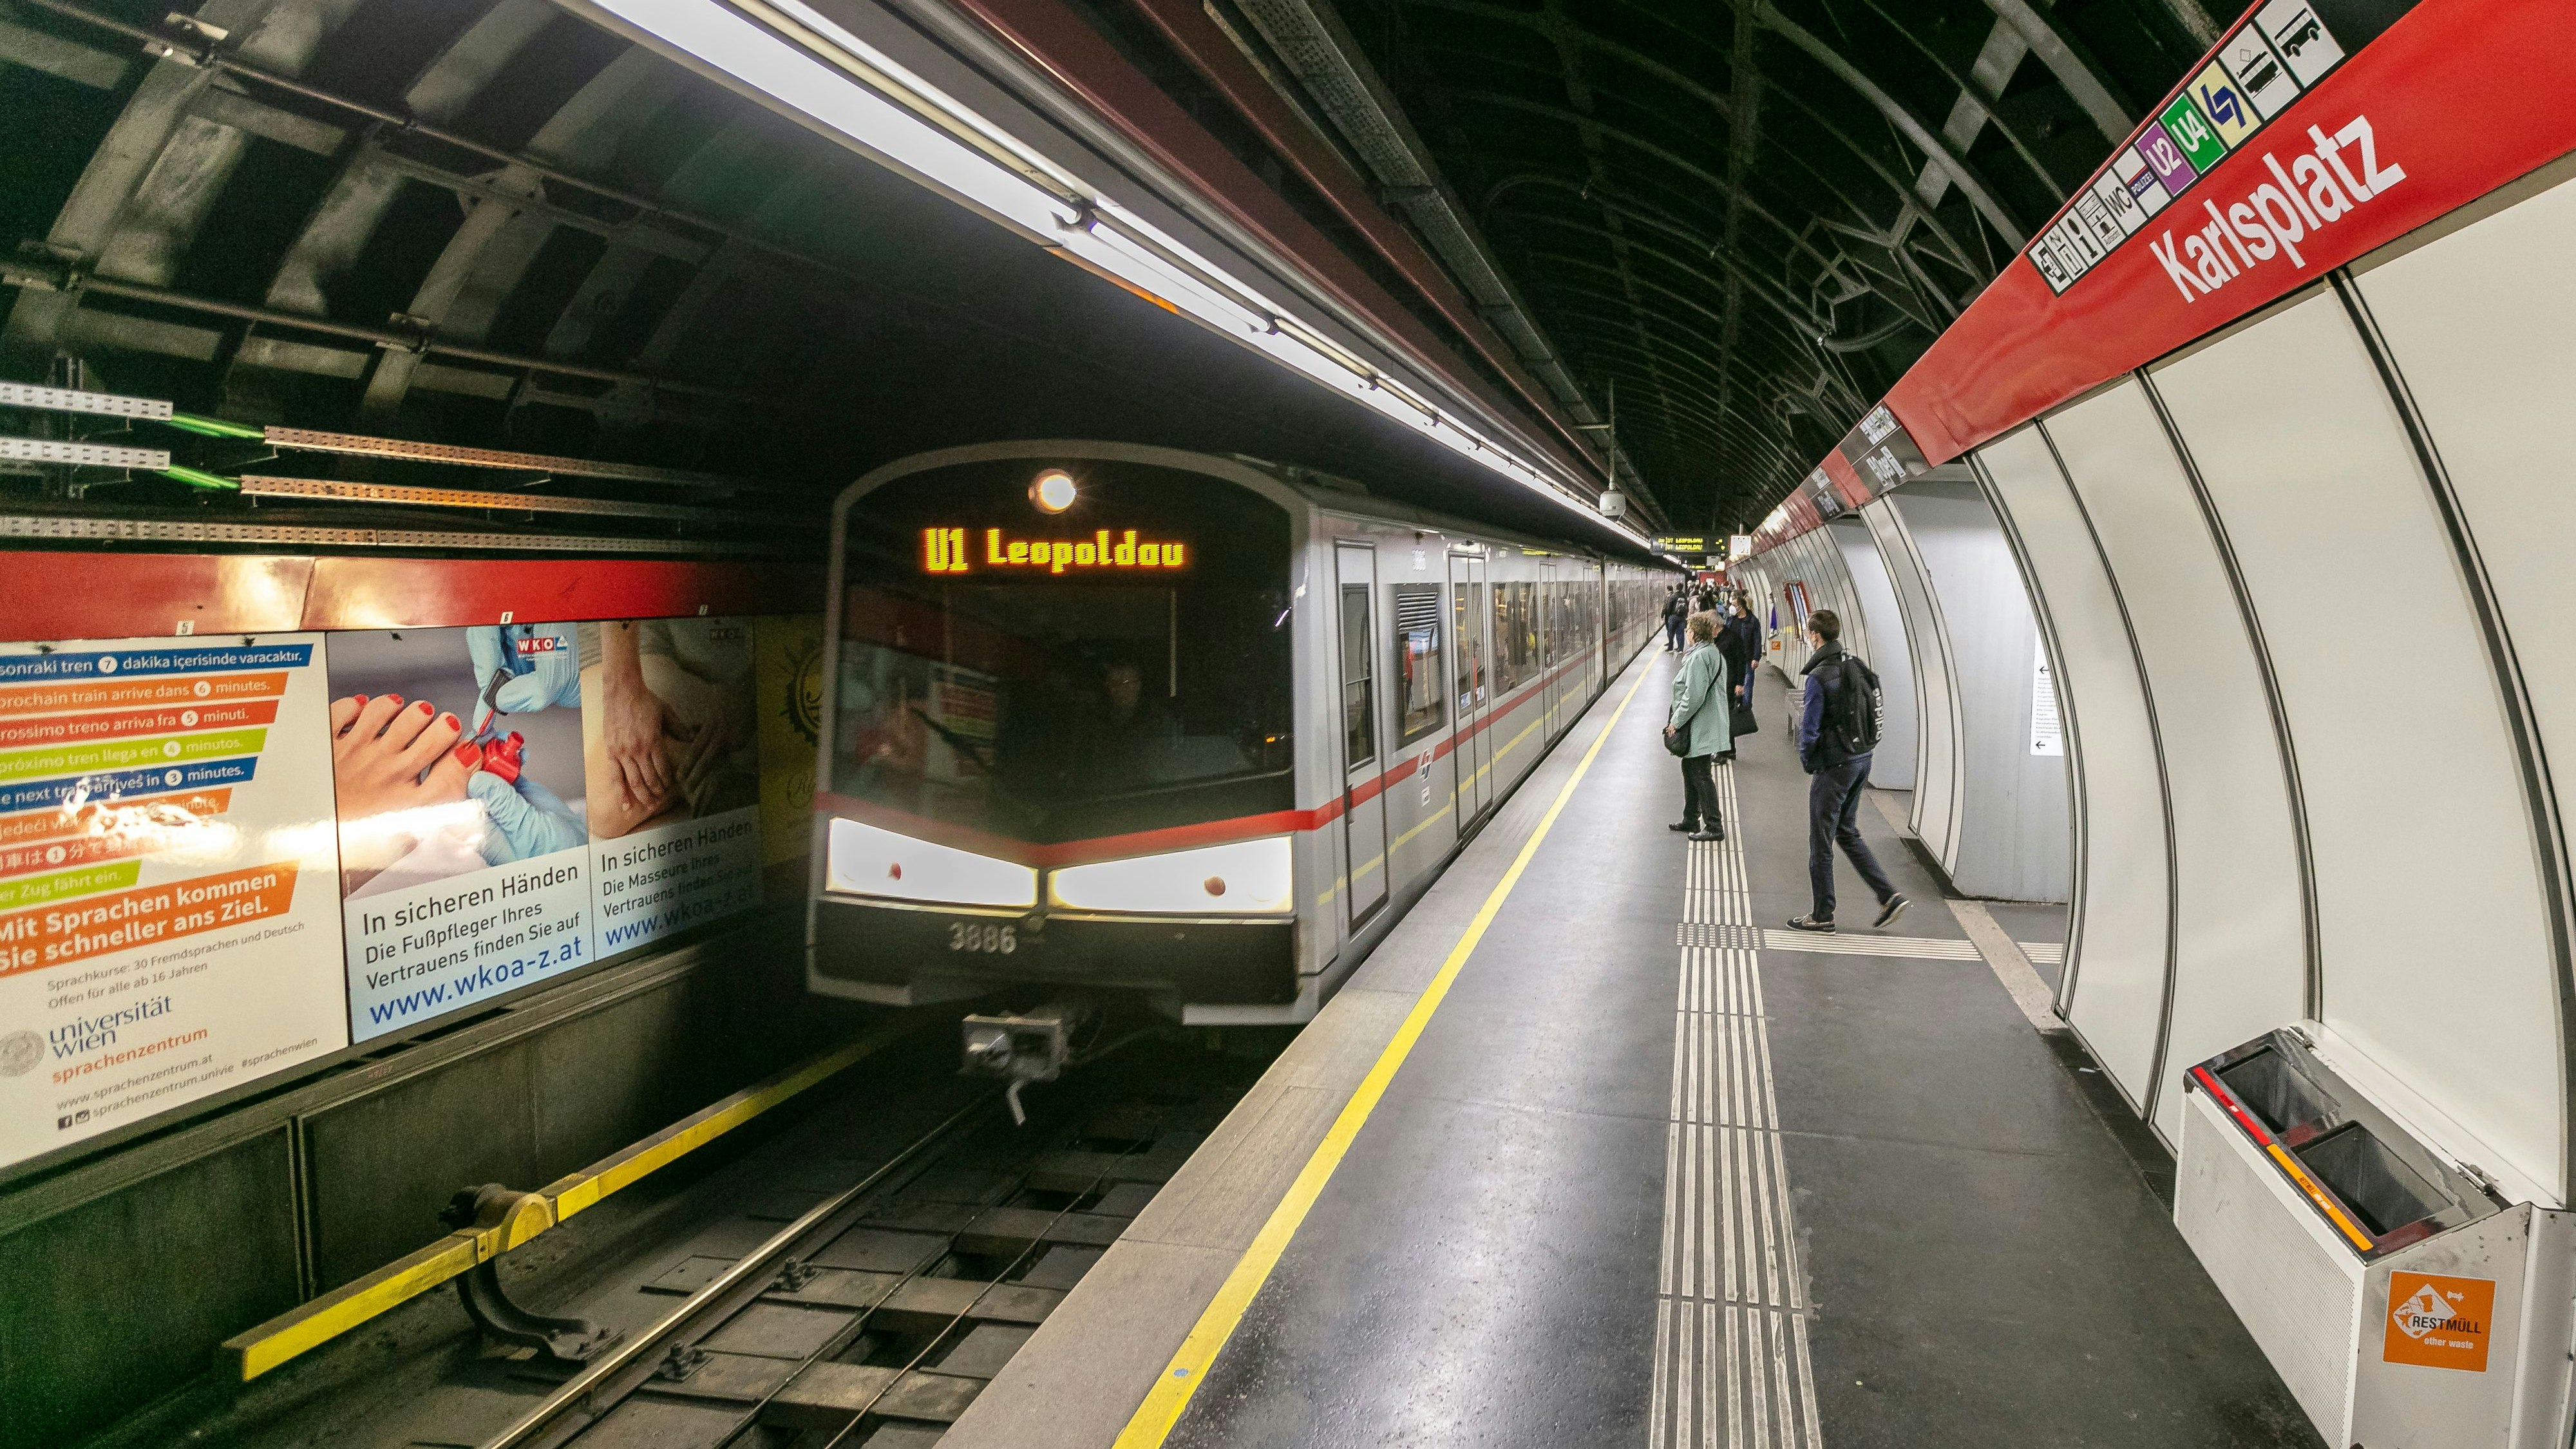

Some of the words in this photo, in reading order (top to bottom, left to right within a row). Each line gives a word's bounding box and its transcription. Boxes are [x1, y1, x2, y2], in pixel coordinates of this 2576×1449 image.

[2171, 109, 2210, 152] U4
[2145, 137, 2183, 176] U2
[2105, 186, 2132, 217] WC
[2130, 171, 2155, 195] POLIZEI
[2150, 115, 2407, 303] Karlsplatz
[925, 527, 968, 572] U1
[987, 528, 1184, 574] Leopoldau
[61, 659, 93, 674] tren
[123, 654, 170, 670] dakika
[173, 652, 236, 670] içerisinde
[518, 638, 553, 652] WKO
[71, 690, 108, 704] train
[111, 687, 153, 701] arrive
[156, 685, 190, 697] dans
[215, 680, 271, 694] minutes.
[1873, 687, 1884, 741] adidas
[68, 722, 109, 735] treno
[113, 715, 155, 732] arriva
[157, 714, 176, 727] fra
[203, 707, 250, 723] minuti.
[68, 753, 99, 766] tren
[102, 748, 137, 763] llega
[140, 746, 158, 758] en
[186, 739, 243, 753] minutos.
[15, 787, 51, 803] next
[147, 774, 160, 787] in
[187, 765, 245, 781] minutes.
[601, 853, 618, 873] In
[623, 837, 693, 867] sicheren
[697, 820, 752, 846] Händen
[21, 884, 52, 899] Zug
[53, 874, 91, 892] fährt
[94, 870, 122, 885] ein.
[603, 877, 624, 896] Die
[629, 862, 688, 889] Masseure
[691, 853, 721, 871] Ihres
[45, 894, 170, 934] Sprachen
[176, 873, 277, 907] kommen
[363, 912, 386, 936] In
[394, 887, 494, 927] sicheren
[502, 866, 578, 898] Händen
[603, 887, 674, 918] Vertrauens
[44, 919, 167, 961] schneller
[173, 909, 215, 933] ans
[220, 895, 269, 922] Ziel.
[366, 943, 396, 965] Die
[402, 915, 498, 954] Fußpfleger
[502, 903, 543, 925] Ihres
[366, 949, 469, 990] Vertrauens
[474, 933, 524, 958] finden
[529, 922, 552, 941] Sie
[556, 911, 580, 933] auf
[47, 965, 131, 991] Sprachkurse:
[134, 956, 148, 971] 30
[151, 938, 238, 967] Fremdsprachen
[241, 931, 261, 945] und
[264, 921, 305, 940] Deutsch
[48, 992, 84, 1009] Offen
[87, 987, 106, 999] für
[108, 979, 131, 994] alle
[133, 974, 149, 988] ab
[151, 971, 166, 984] 16
[168, 961, 208, 980] Jahren
[370, 936, 582, 1025] www.wkoa-z.at
[49, 996, 173, 1045] universität
[52, 1028, 116, 1059] wien
[52, 1028, 209, 1084] sprachenzentrum
[57, 1053, 213, 1110] www.sprachenzentrum.at
[92, 1064, 235, 1118] sprachenzentrum.univie
[242, 1037, 318, 1069] #sprachenwien
[2412, 1316, 2482, 1334] RESTMÜLL
[2424, 1337, 2447, 1347] other
[2448, 1340, 2474, 1349] waste
